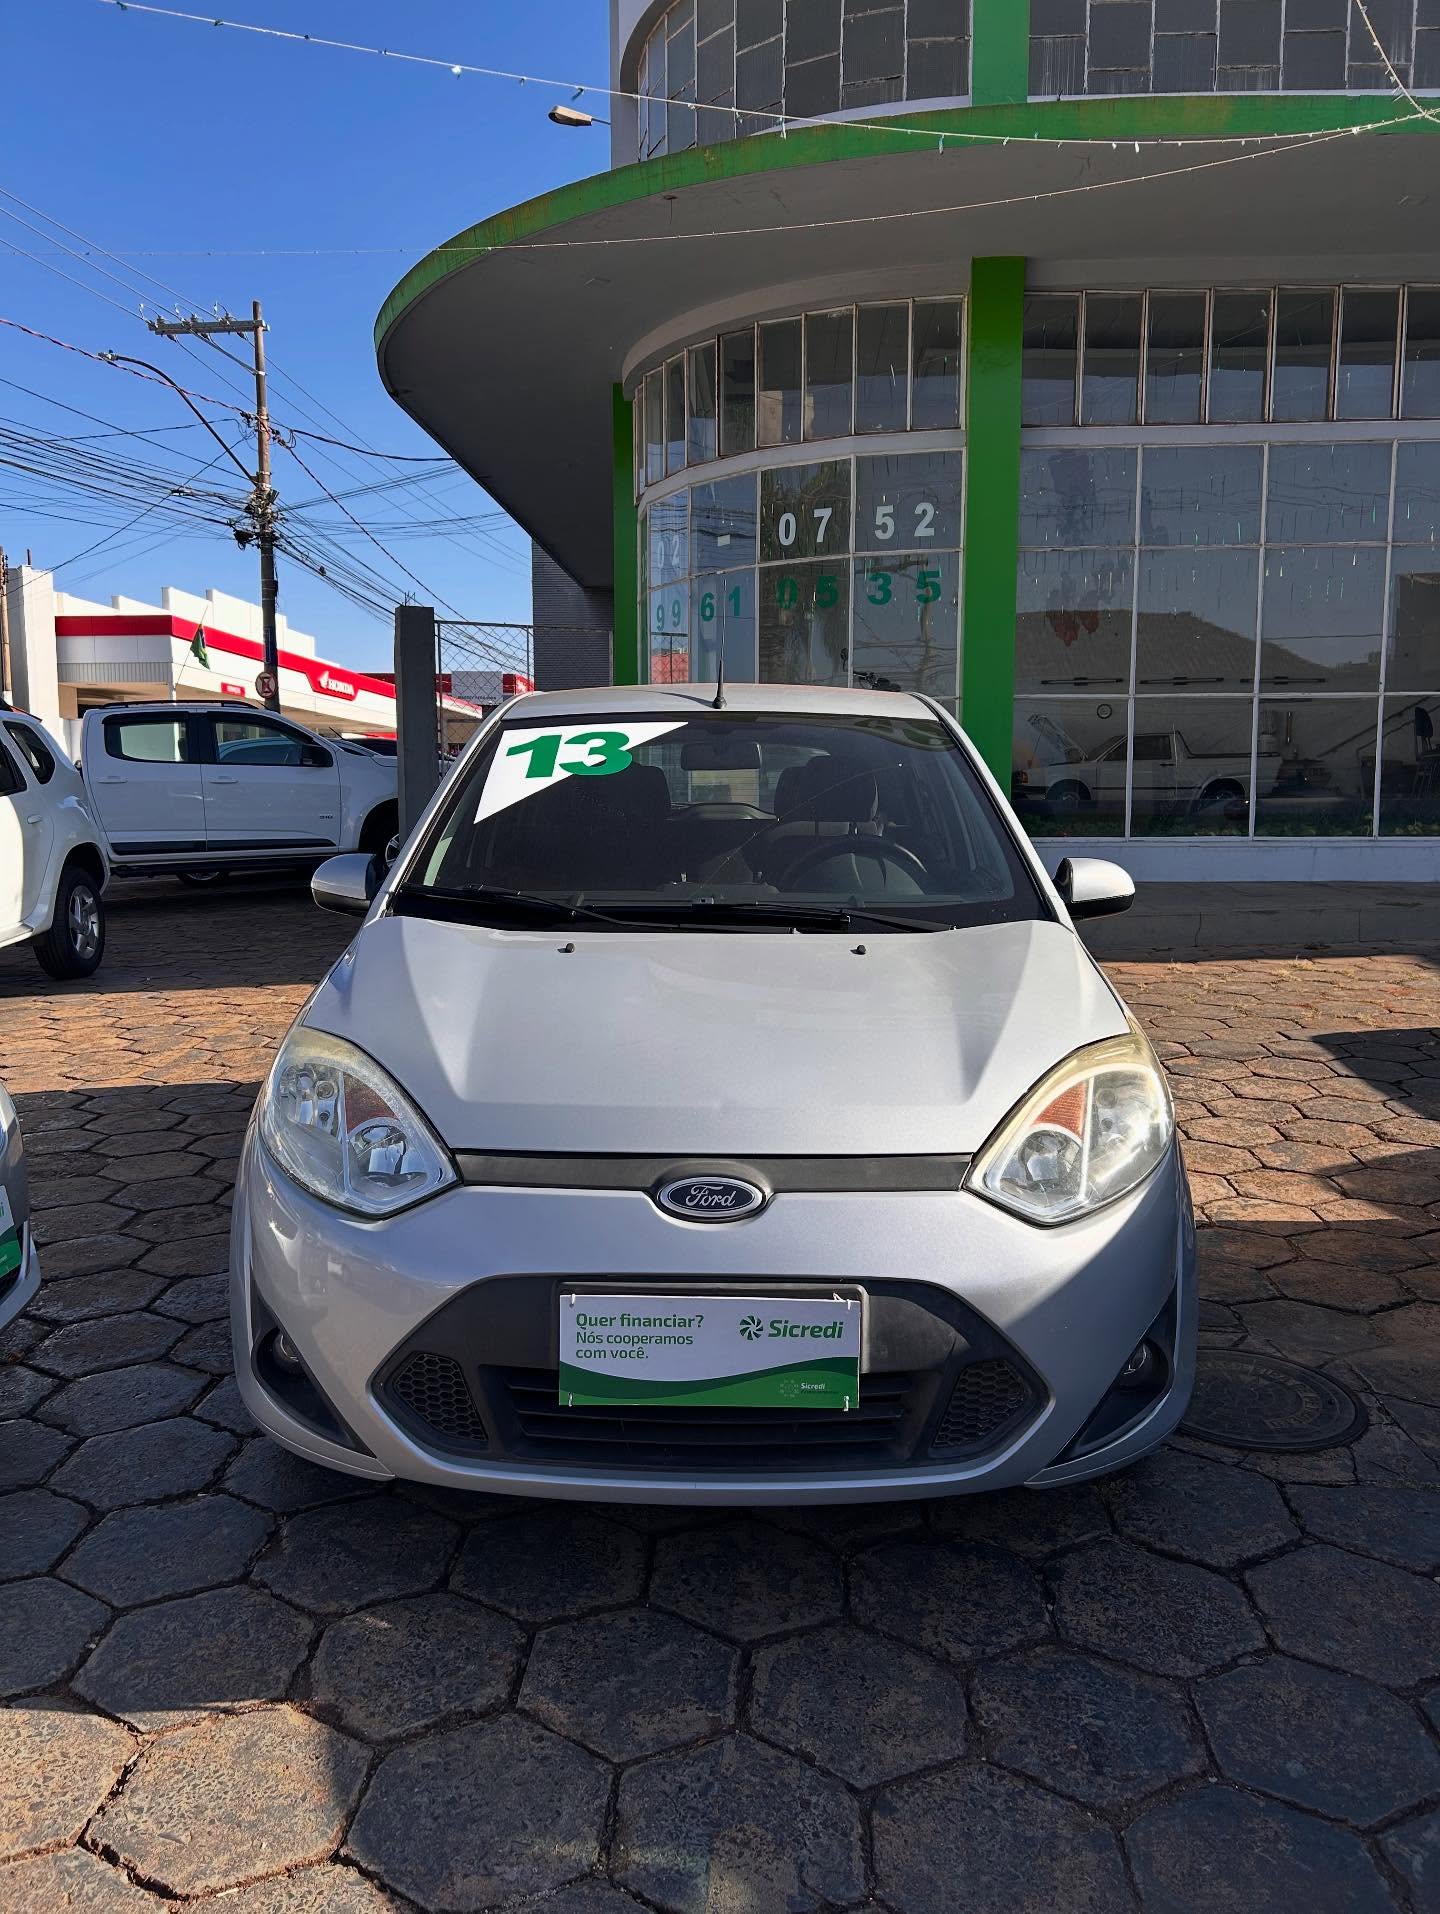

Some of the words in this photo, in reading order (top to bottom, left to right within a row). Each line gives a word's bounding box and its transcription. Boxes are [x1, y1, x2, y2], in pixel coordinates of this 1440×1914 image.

[779, 507, 833, 546] 07
[874, 501, 935, 540] 52
[656, 599, 681, 631] 99
[699, 585, 741, 622] 61
[776, 575, 839, 609] 05
[866, 570, 942, 605] 35
[505, 730, 633, 779] 13
[685, 1184, 737, 1206] Ford
[575, 1313, 616, 1330] Quer
[620, 1313, 704, 1328] financiar?
[768, 1319, 844, 1338] Sicredi
[576, 1331, 603, 1344] Nós
[606, 1334, 694, 1347] cooperamos
[575, 1349, 606, 1359] com
[610, 1347, 649, 1359] você.
[800, 1382, 826, 1390] Sicredi
